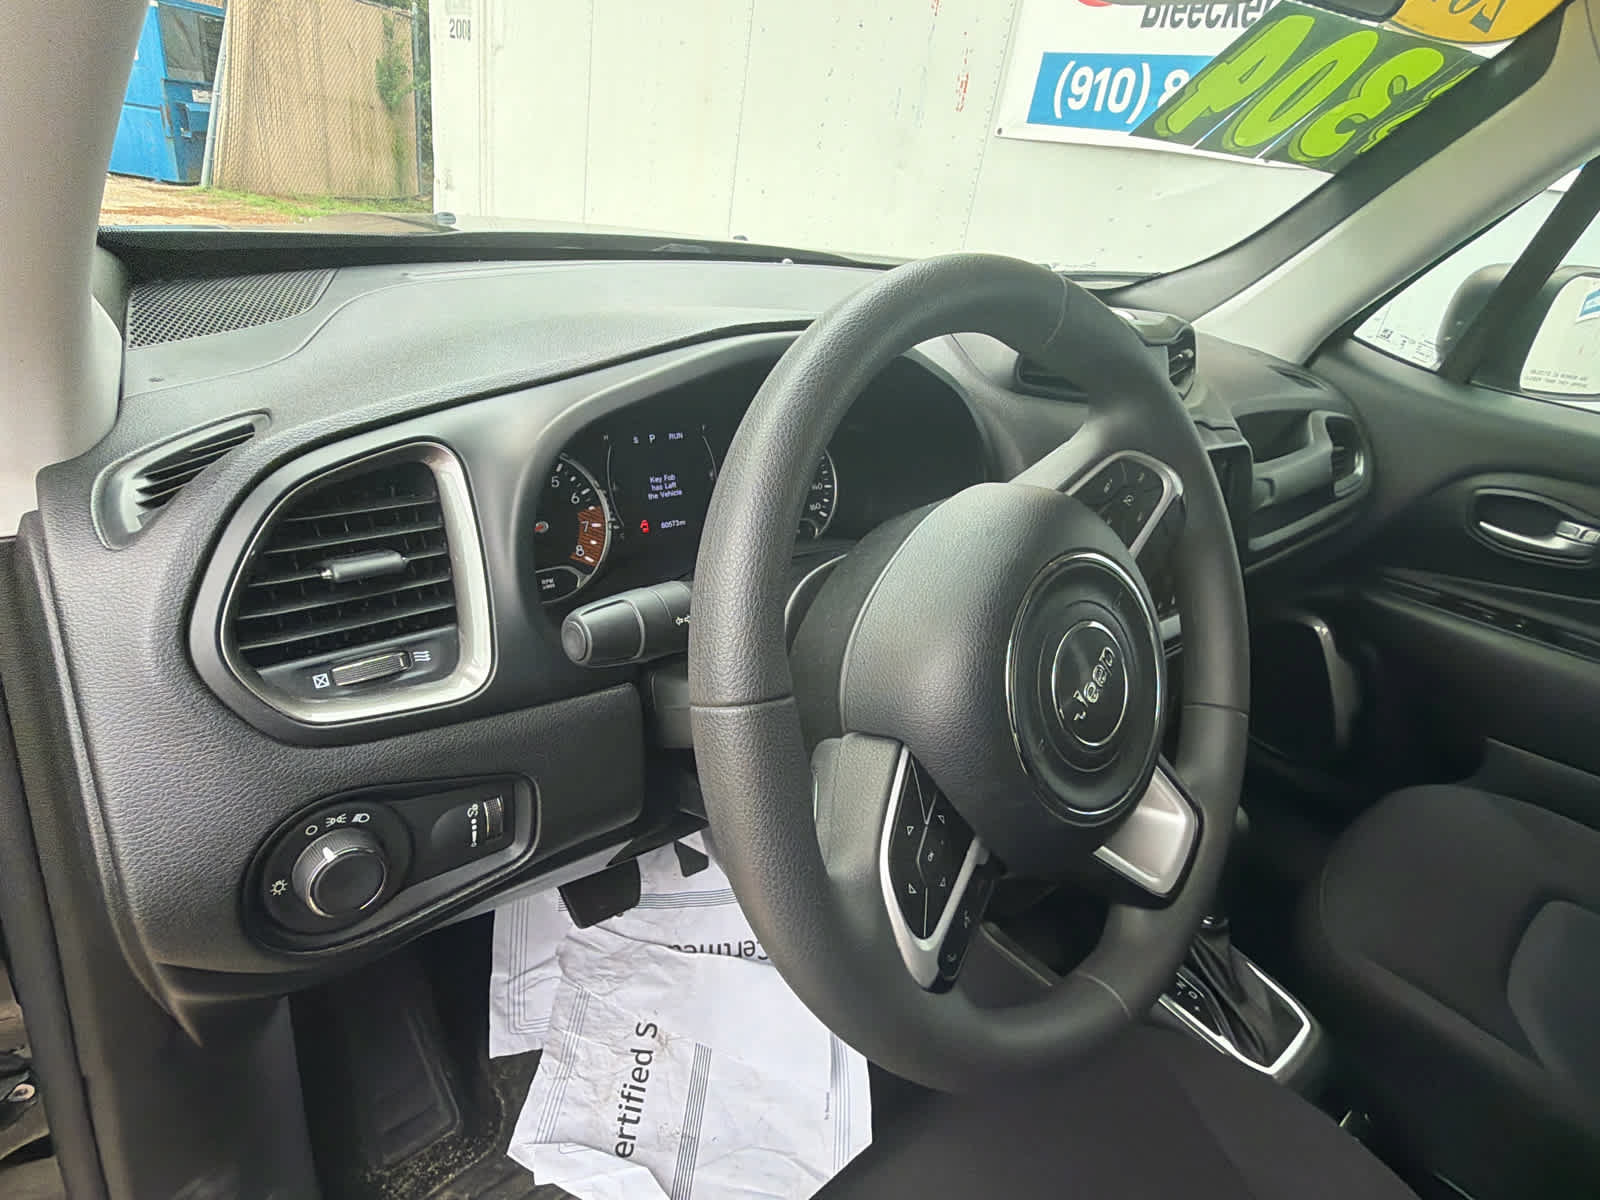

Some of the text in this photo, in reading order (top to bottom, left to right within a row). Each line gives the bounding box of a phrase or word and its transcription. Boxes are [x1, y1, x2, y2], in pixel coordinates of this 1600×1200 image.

[1053, 60, 1150, 124] (910)
[649, 433, 656, 443] P
[668, 432, 684, 440] RUN
[551, 476, 560, 488] 5
[570, 493, 580, 504] 6
[660, 489, 683, 498] Vehicle
[581, 520, 590, 532] 7
[575, 544, 585, 557] 8
[1071, 646, 1116, 721] Jeep
[614, 1021, 658, 1159] ertified S
